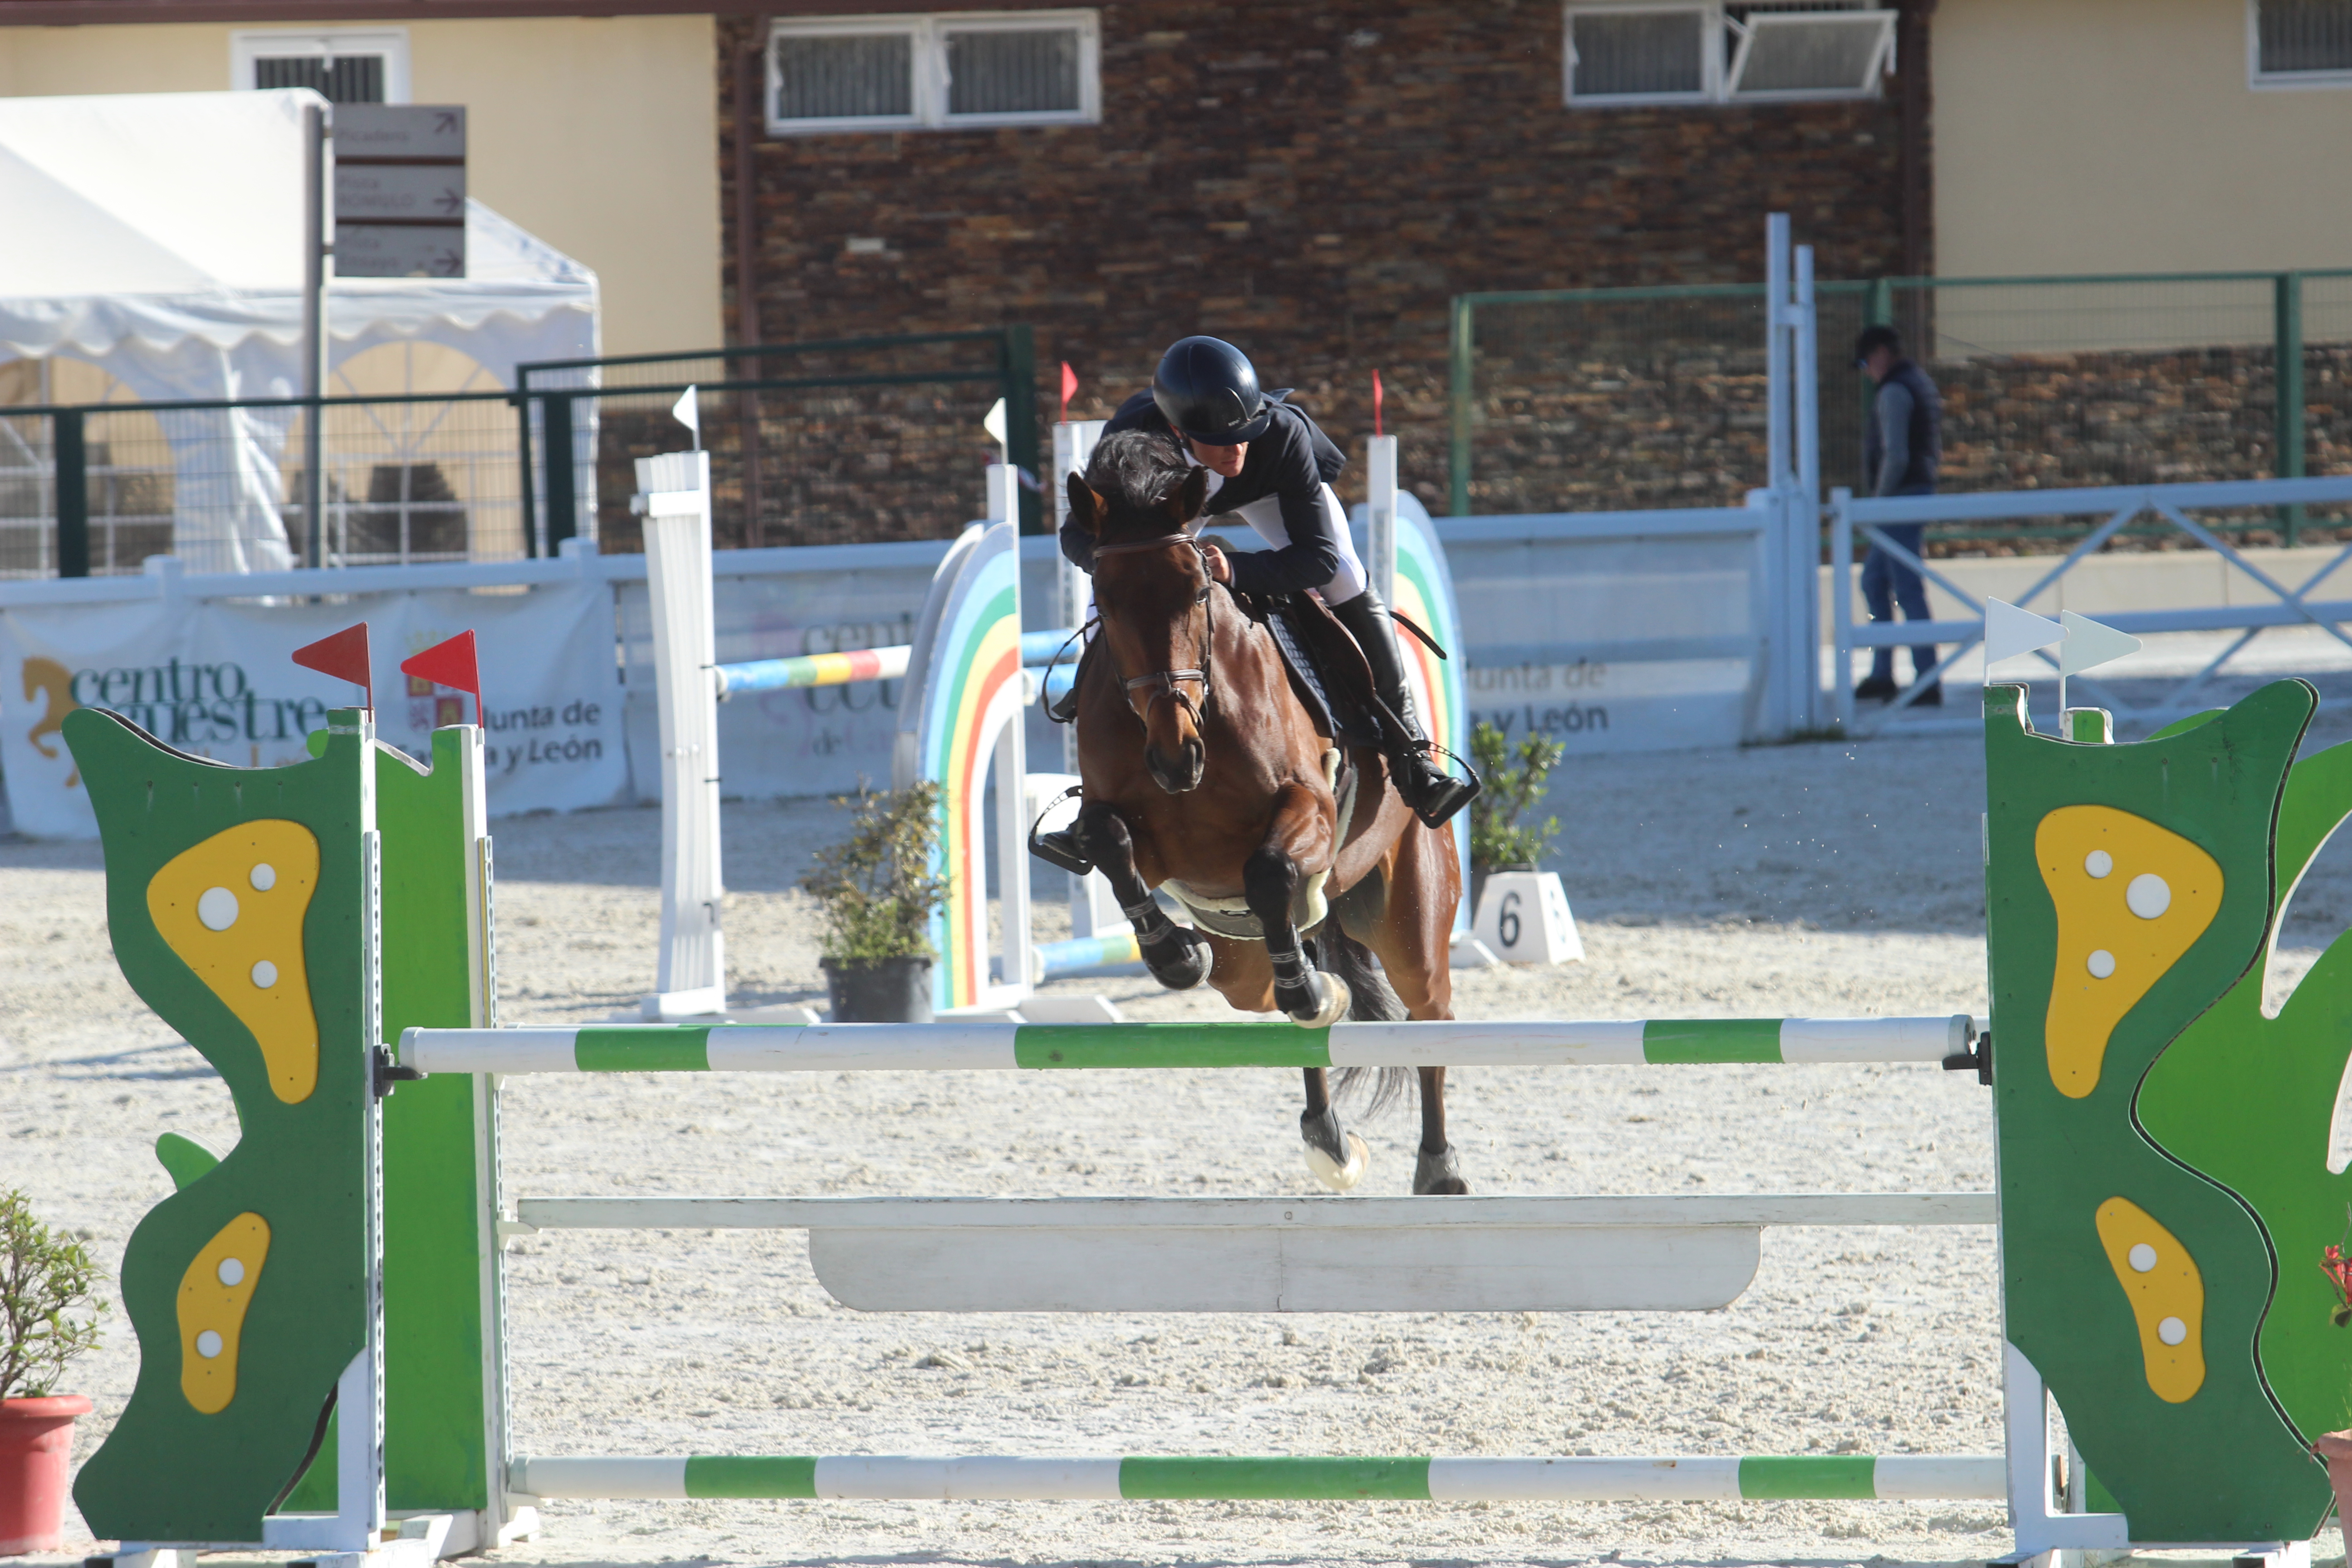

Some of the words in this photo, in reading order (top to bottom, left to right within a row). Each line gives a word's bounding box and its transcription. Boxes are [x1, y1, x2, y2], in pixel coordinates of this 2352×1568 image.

[70, 656, 246, 707] centro
[562, 698, 601, 726] de
[505, 745, 523, 775] y
[528, 733, 604, 763] León
[1499, 891, 1520, 947] 6
